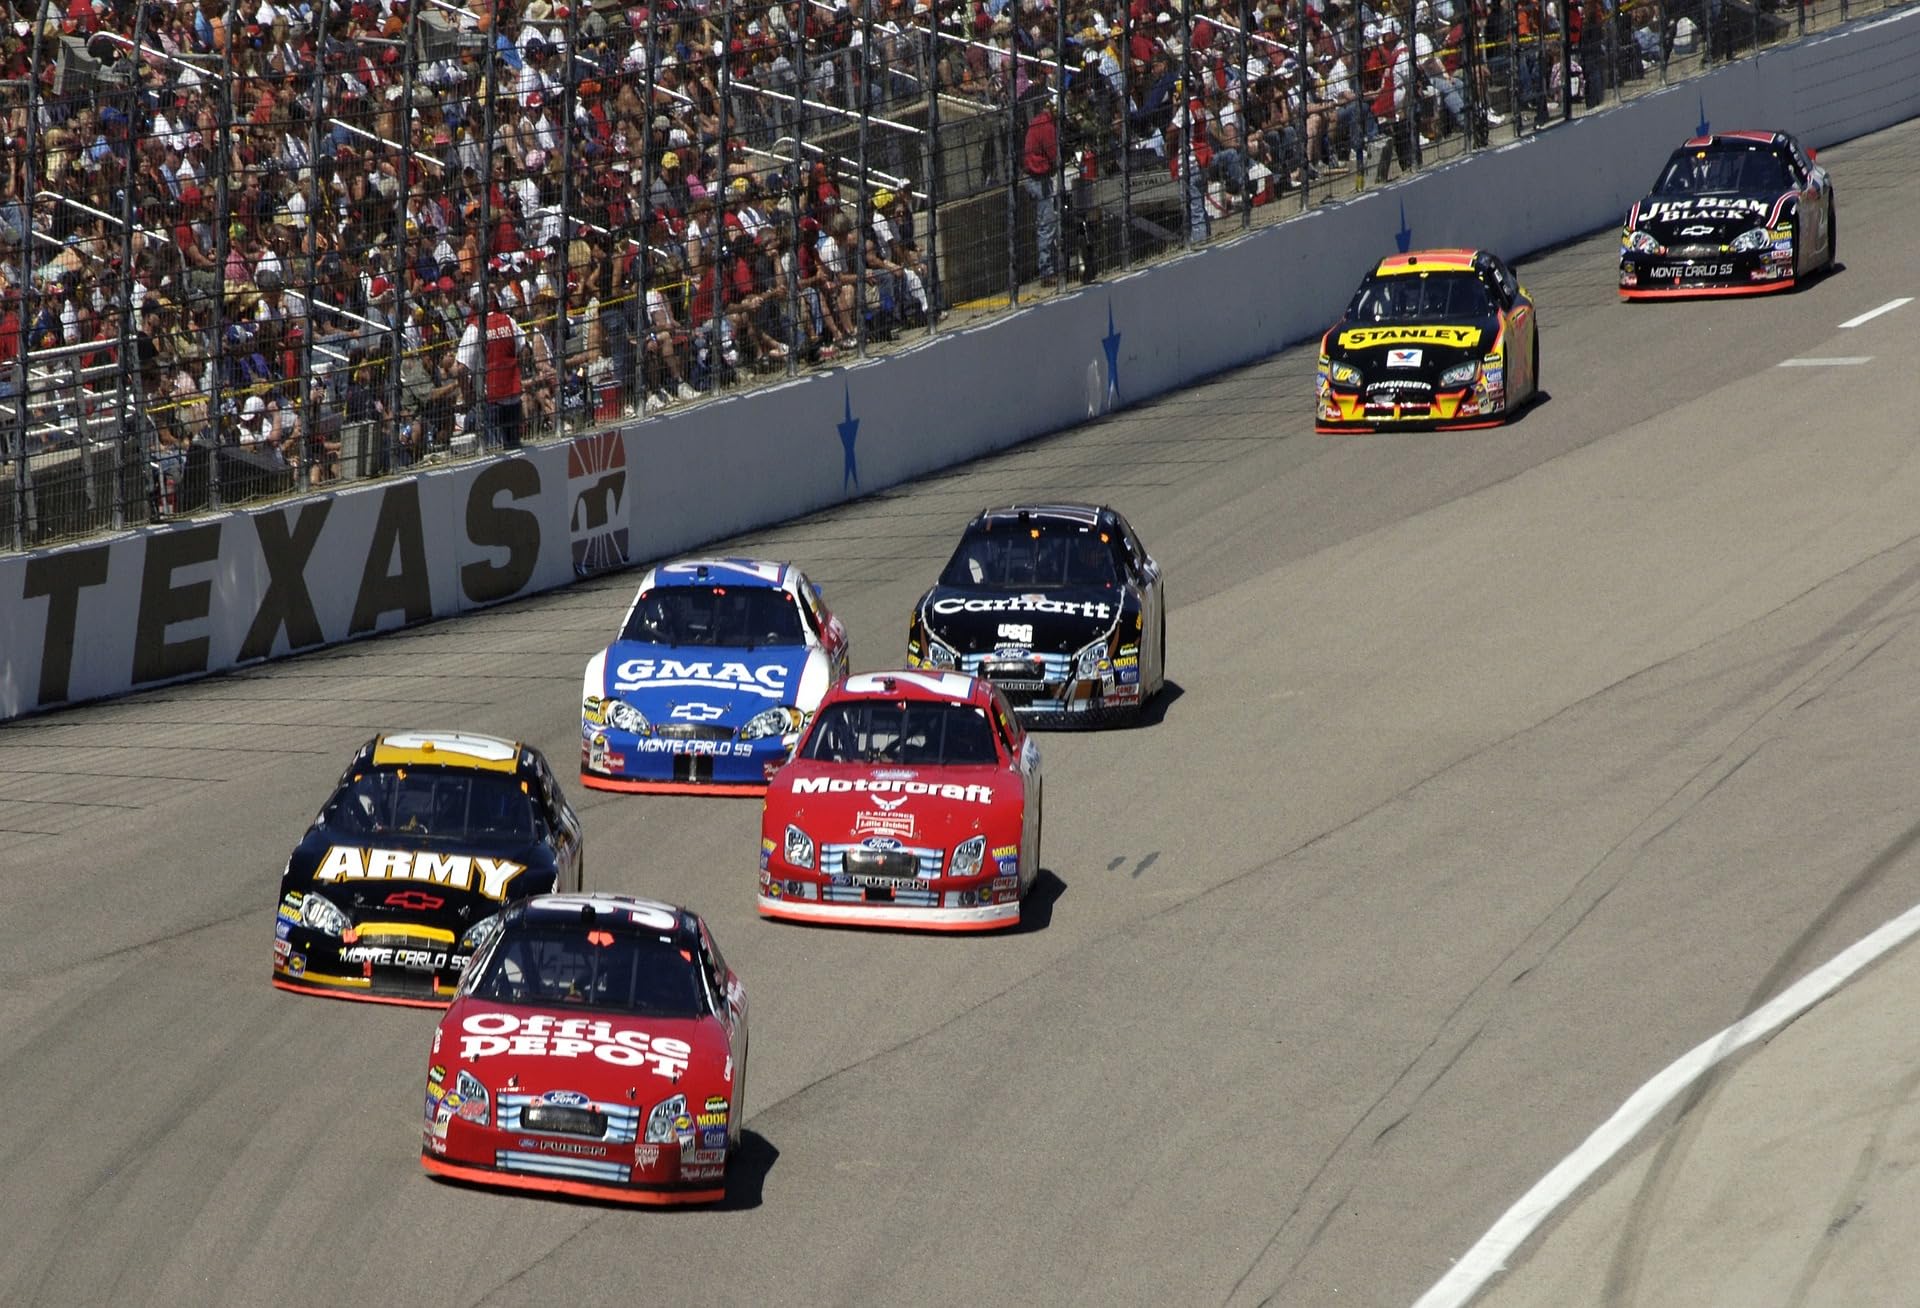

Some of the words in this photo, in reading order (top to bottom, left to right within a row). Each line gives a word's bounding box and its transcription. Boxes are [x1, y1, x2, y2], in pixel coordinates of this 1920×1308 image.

[1639, 201, 1693, 222] JIM
[1696, 197, 1769, 217] BEAM
[1660, 209, 1746, 222] BLACK
[1650, 267, 1683, 278] MONTE
[1684, 264, 1717, 277] CARLO
[1718, 263, 1734, 275] SS
[1349, 329, 1469, 344] STANLEY
[1337, 367, 1353, 381] 10
[1366, 380, 1432, 391] CHARGER
[23, 458, 541, 706] TEXAS
[934, 597, 1110, 618] Carhartt
[997, 623, 1033, 643] USG
[617, 659, 788, 688] GMAC
[637, 738, 683, 753] MONTE
[684, 740, 731, 756] CARLO
[732, 743, 753, 757] SS
[792, 777, 994, 804] Motorcraft
[790, 844, 811, 860] 21
[312, 846, 527, 901] ARMY
[853, 875, 929, 890] FUSION
[339, 947, 393, 965] MONTE
[394, 949, 447, 969] CARLO
[462, 1013, 691, 1058] Office
[459, 1035, 690, 1079] DEPOT
[548, 1091, 584, 1105] Ford
[696, 1113, 727, 1125] MOOG
[540, 1140, 607, 1156] FUSION
